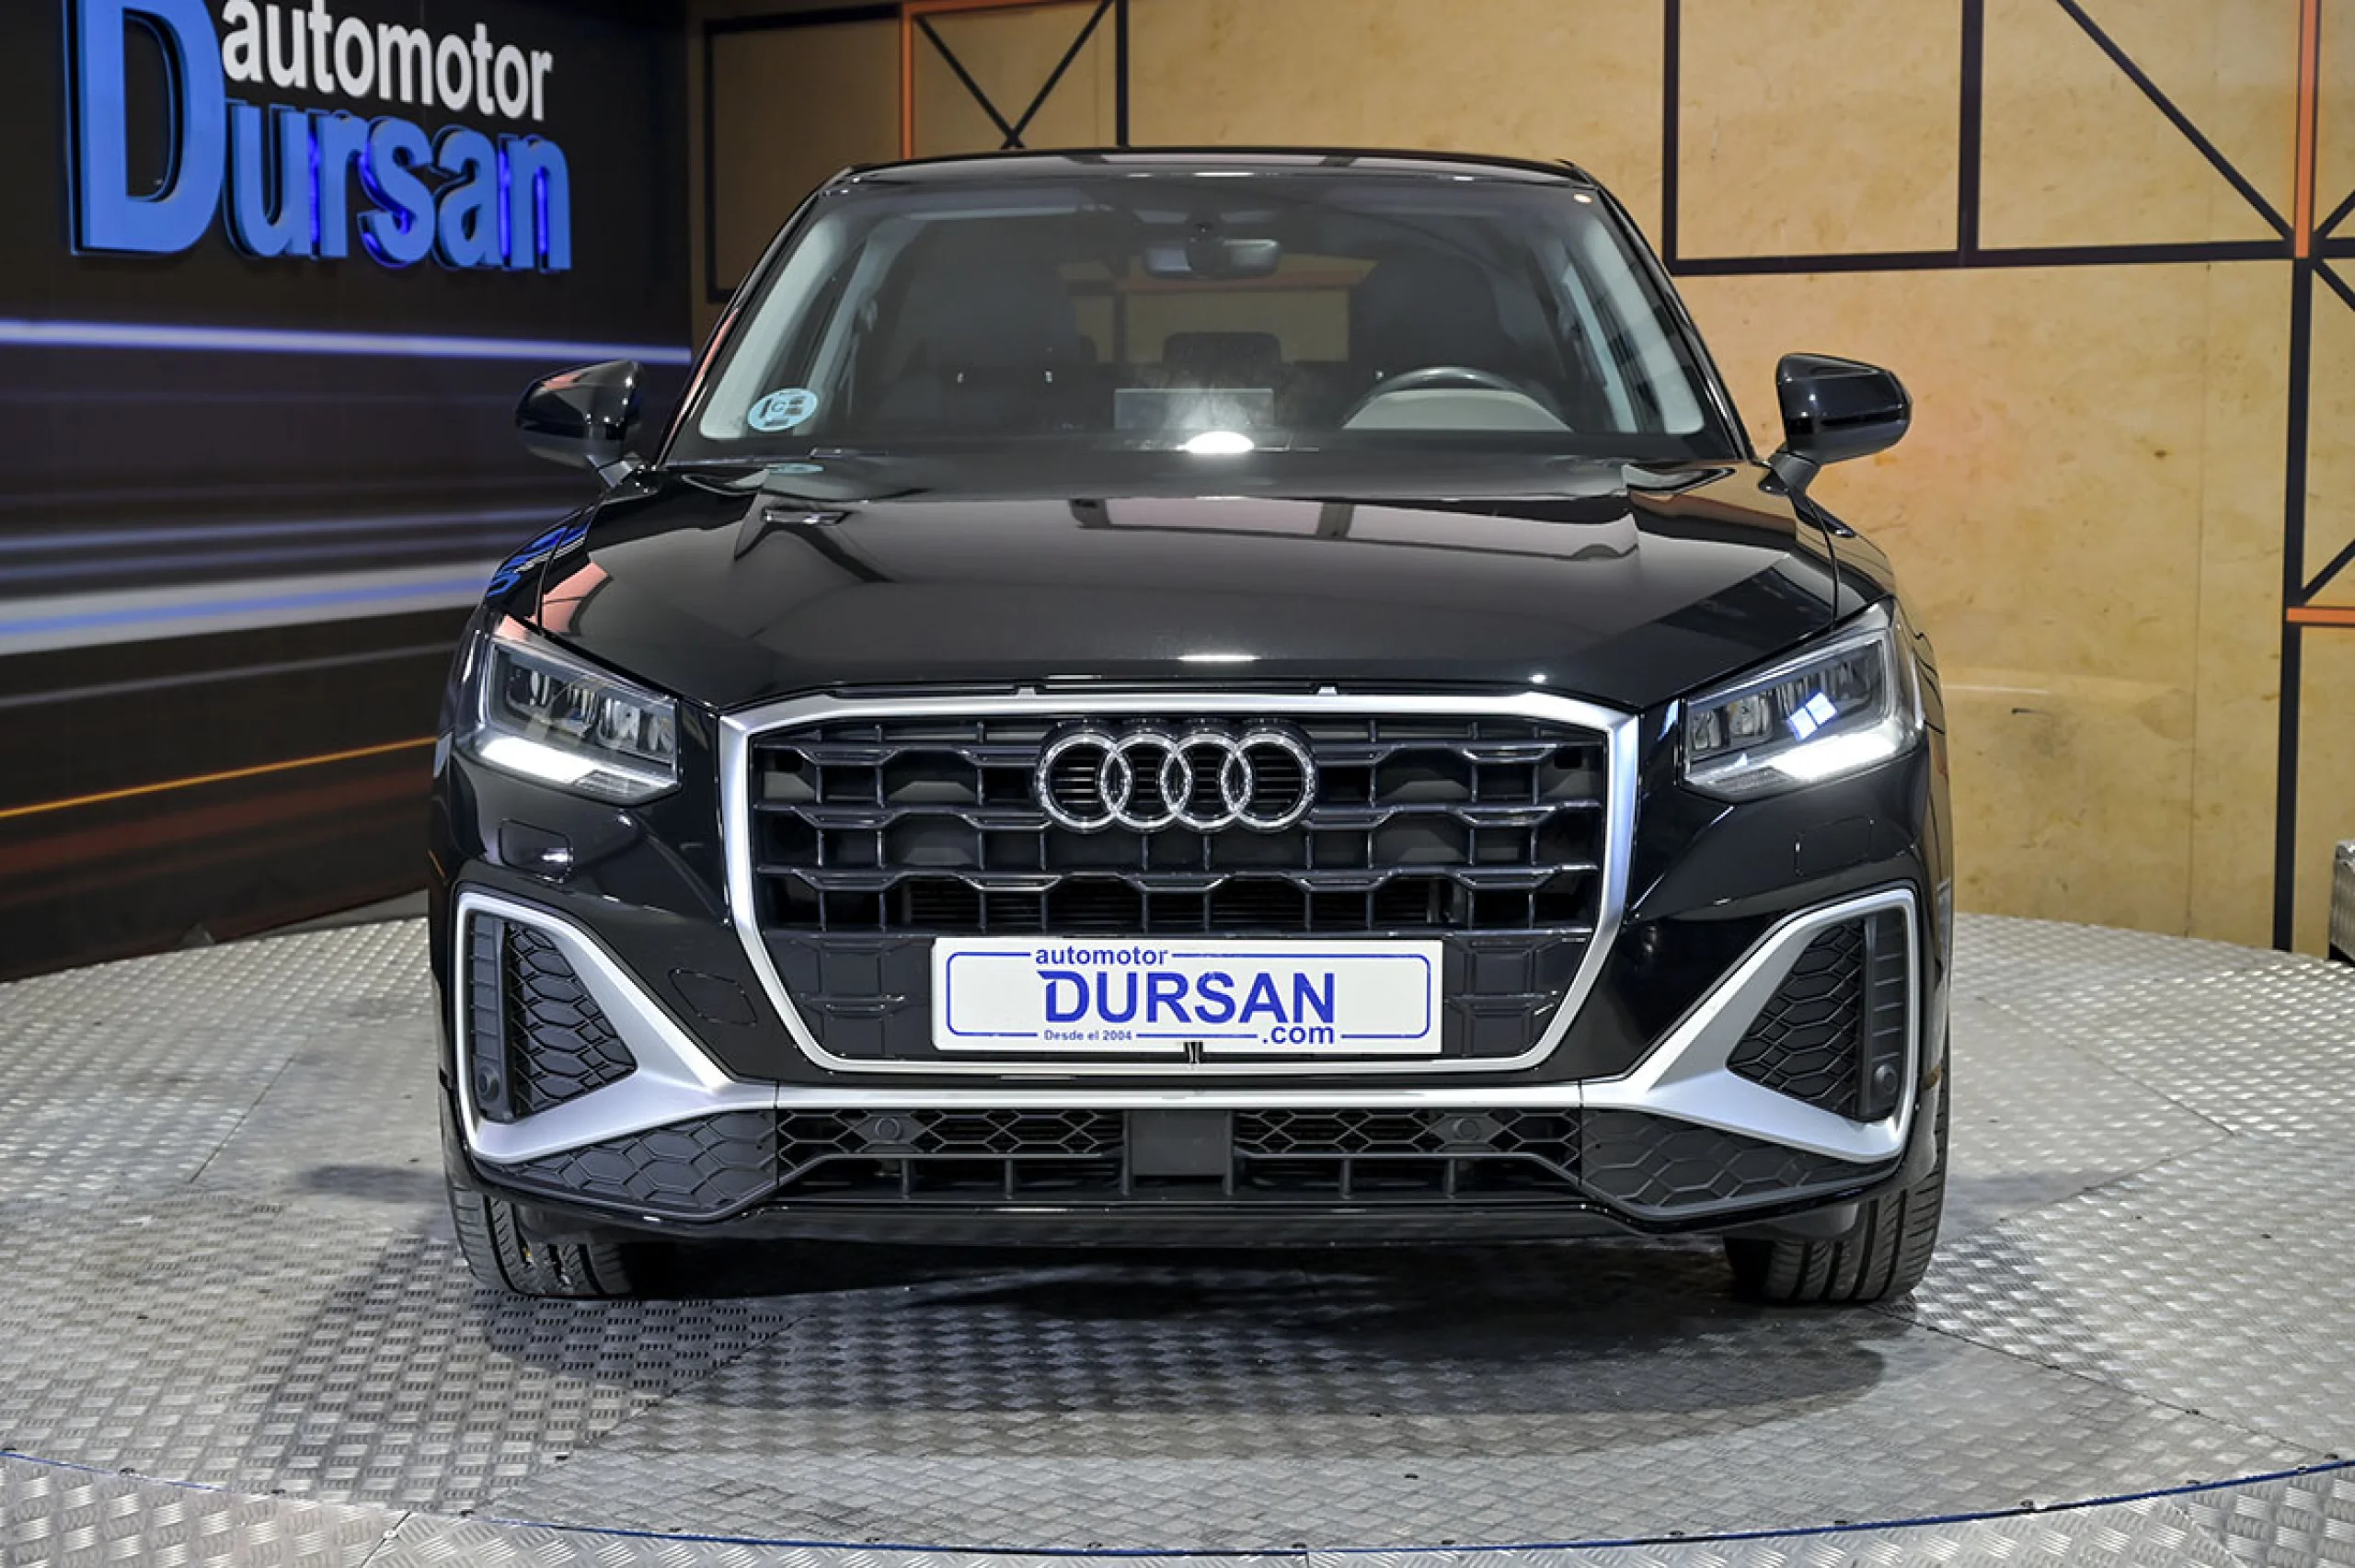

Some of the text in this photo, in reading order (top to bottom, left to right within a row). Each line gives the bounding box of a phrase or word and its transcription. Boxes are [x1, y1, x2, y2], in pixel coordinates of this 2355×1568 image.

[222, 0, 553, 120] automotor
[68, 0, 571, 270] Dursan
[1036, 945, 1167, 965] automotor
[1037, 970, 1336, 1024] DURSAN
[1044, 1029, 1132, 1040] Desde el 2004
[1262, 1025, 1335, 1045] .com
